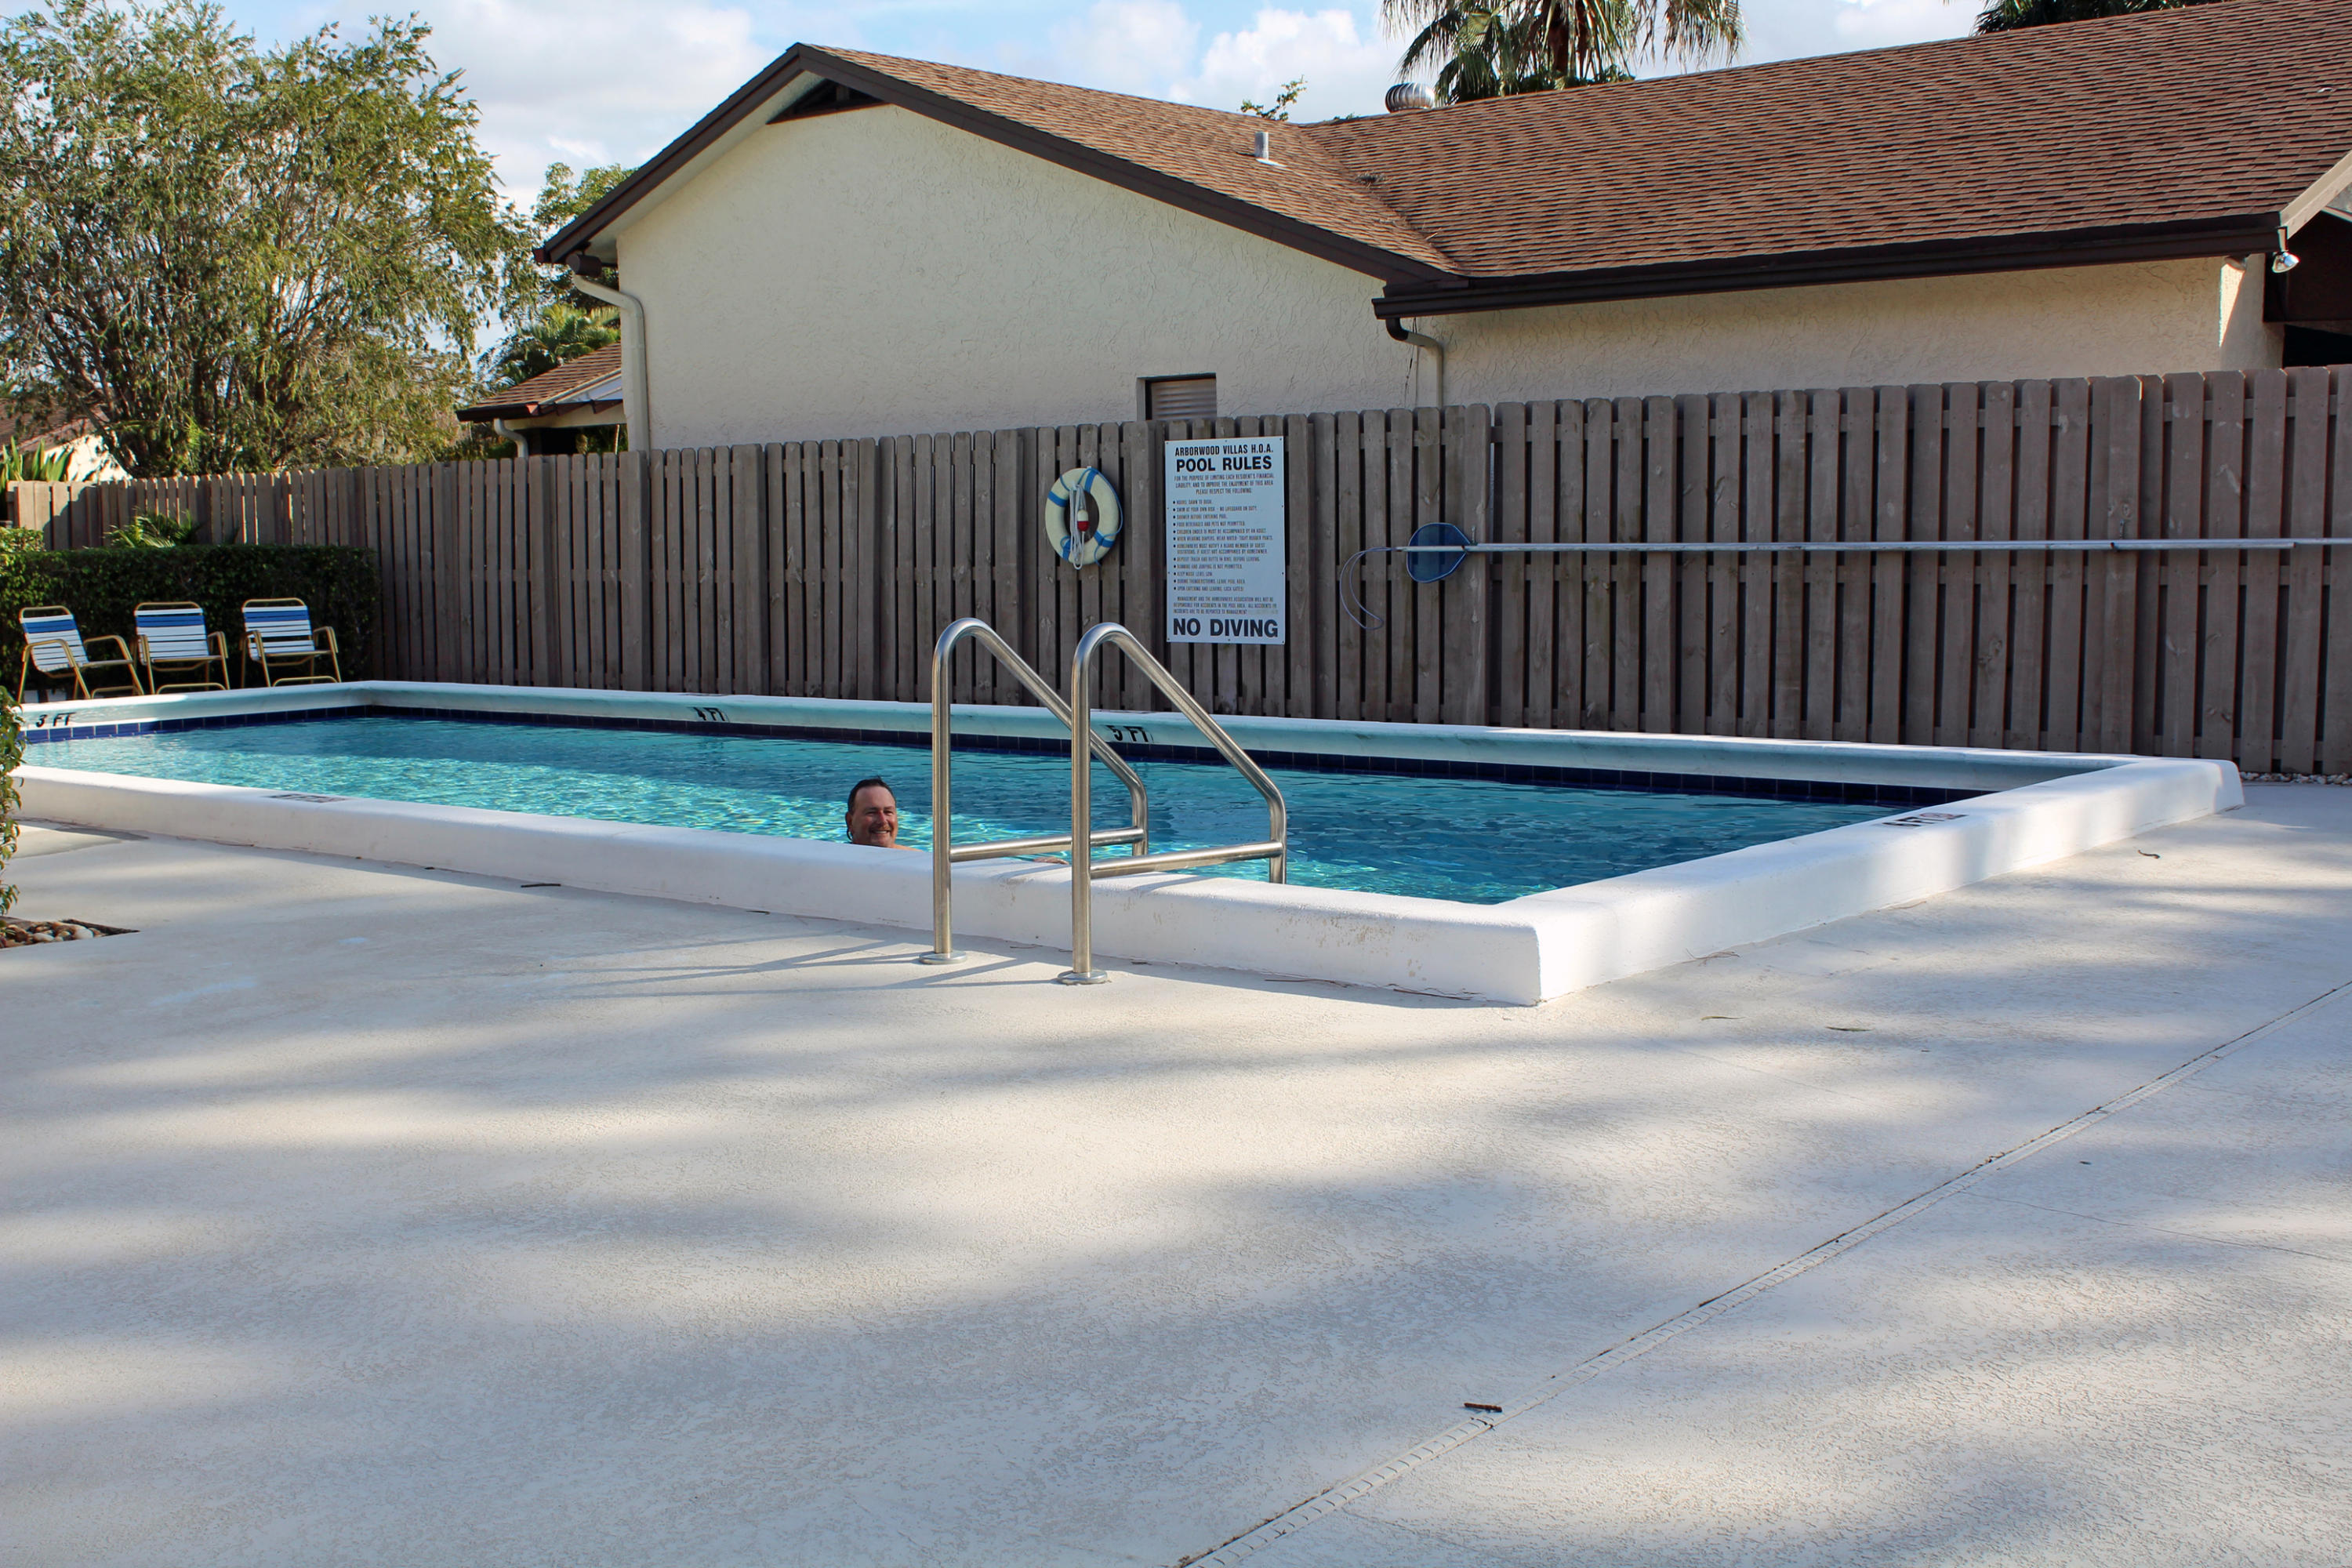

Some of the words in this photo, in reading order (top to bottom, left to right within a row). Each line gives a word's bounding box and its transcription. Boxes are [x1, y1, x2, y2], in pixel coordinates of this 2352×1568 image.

[1175, 445, 1220, 456] ARBORWOOD
[1223, 445, 1248, 454] VILLAS
[1251, 443, 1274, 453] H.O.A.
[1176, 458, 1216, 472] POOL
[1222, 456, 1272, 470] RULES
[1174, 618, 1200, 636] NO
[1210, 619, 1278, 637] DIVING
[35, 714, 48, 728] 3
[53, 712, 77, 727] FT
[1105, 724, 1123, 742] 5
[1123, 726, 1149, 742] FT
